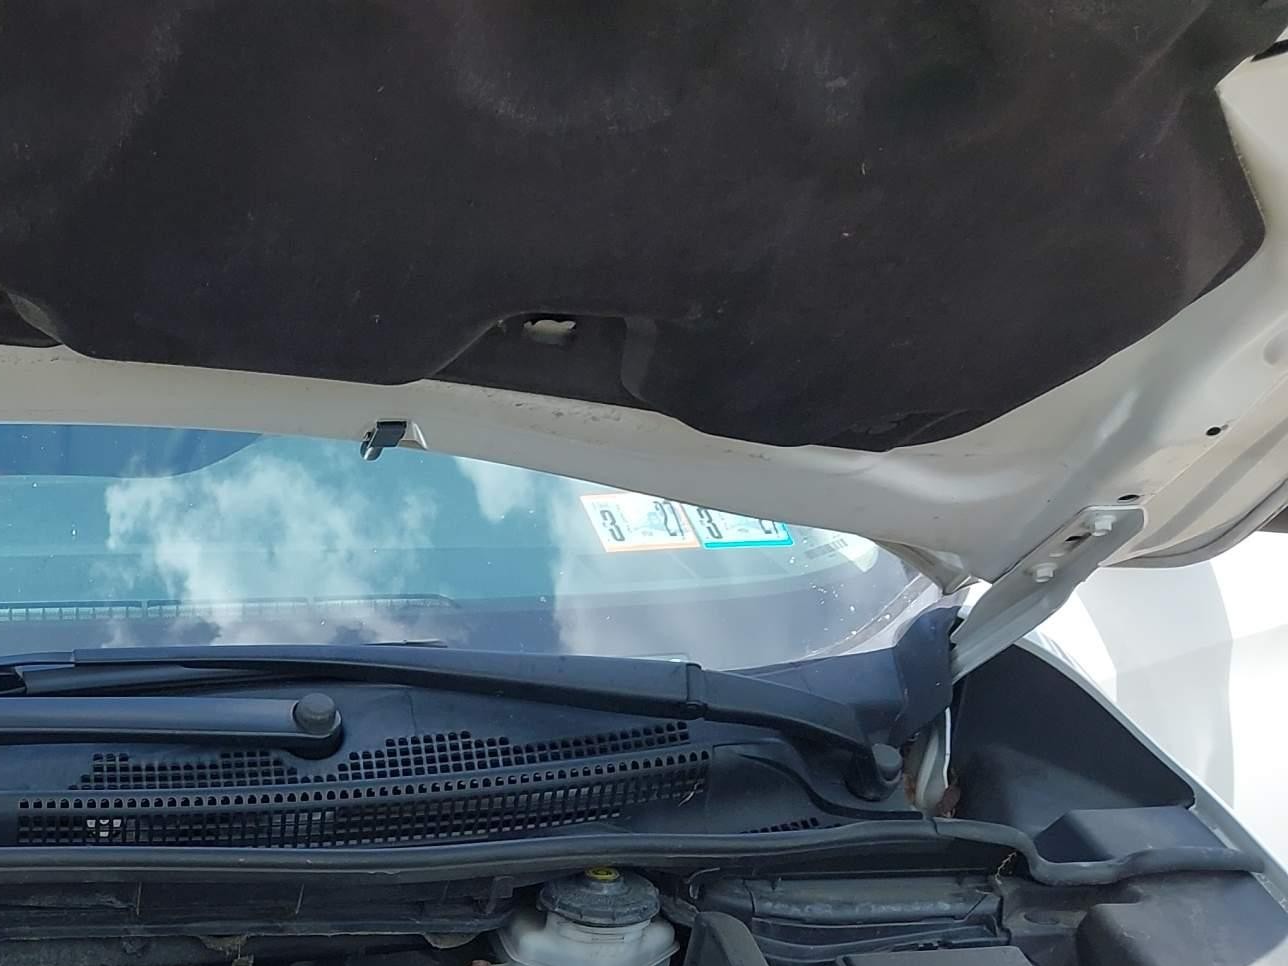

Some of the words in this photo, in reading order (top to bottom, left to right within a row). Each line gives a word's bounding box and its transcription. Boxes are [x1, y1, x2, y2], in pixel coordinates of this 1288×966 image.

[600, 510, 625, 541] 3
[654, 501, 684, 536] 27
[697, 507, 722, 539] 3
